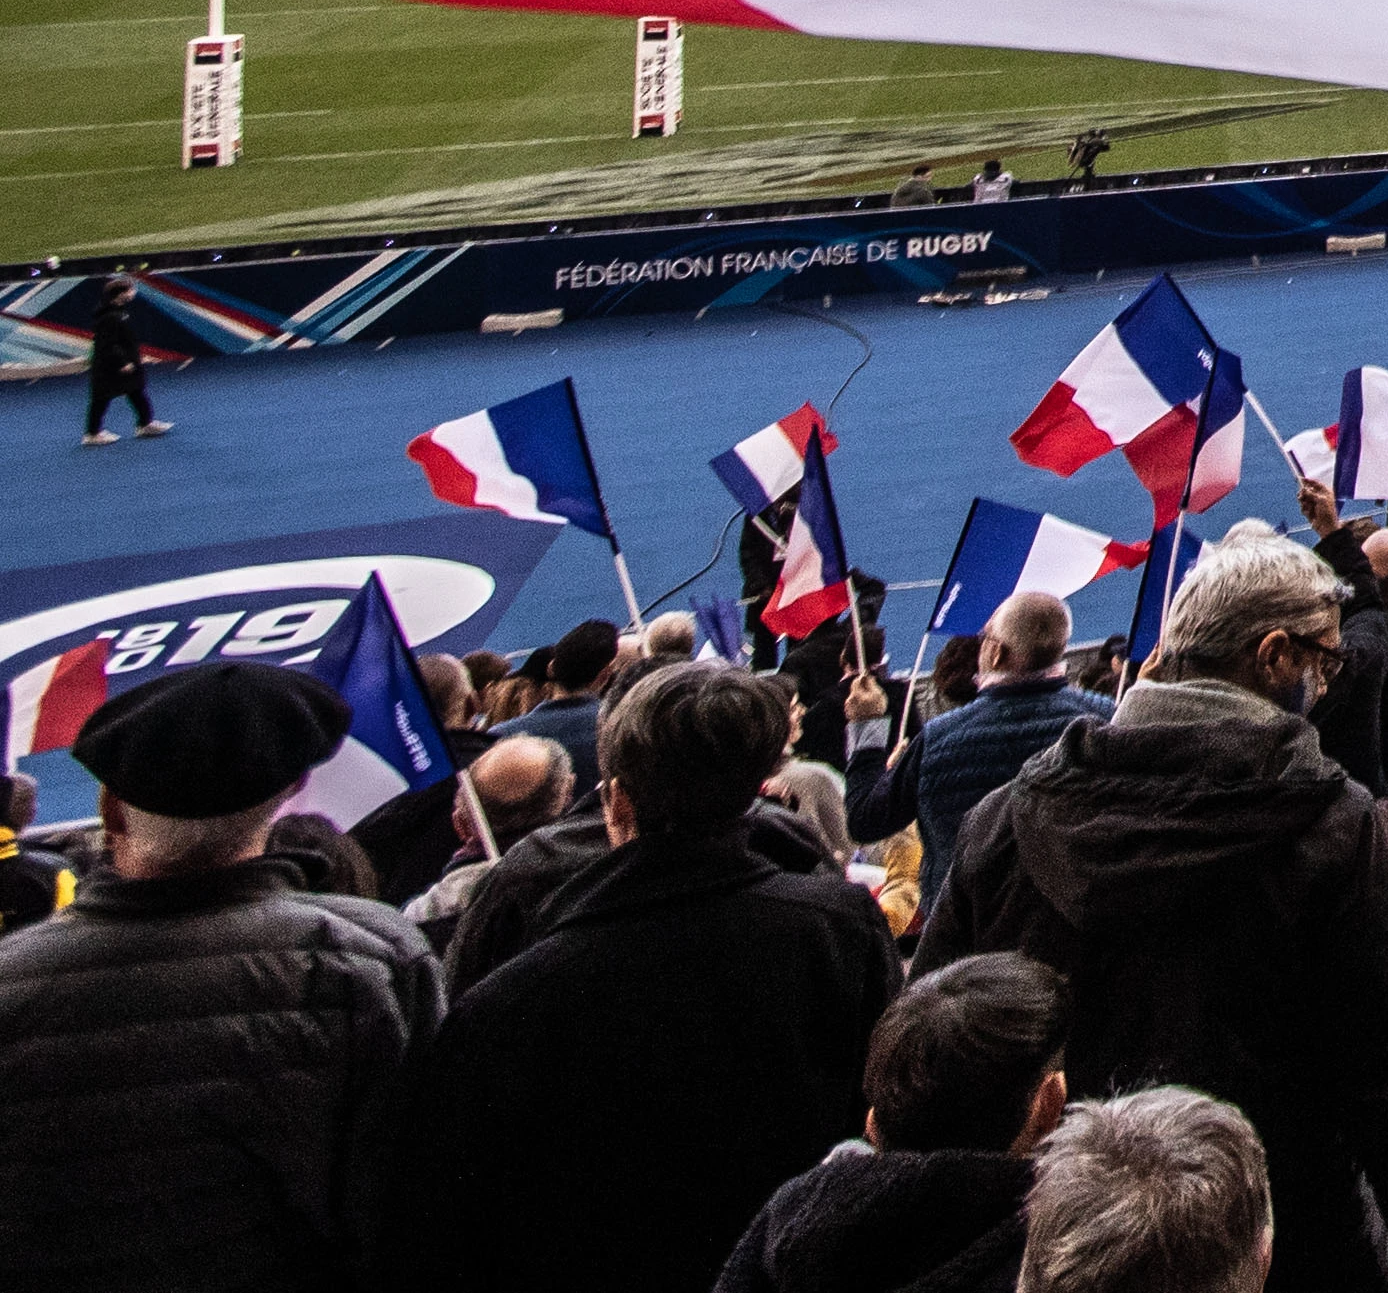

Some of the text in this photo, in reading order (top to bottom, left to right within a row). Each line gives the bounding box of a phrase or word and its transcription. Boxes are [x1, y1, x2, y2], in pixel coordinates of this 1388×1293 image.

[555, 231, 994, 290] FÉDÉRATION FRANÇAISE DE RUGBY
